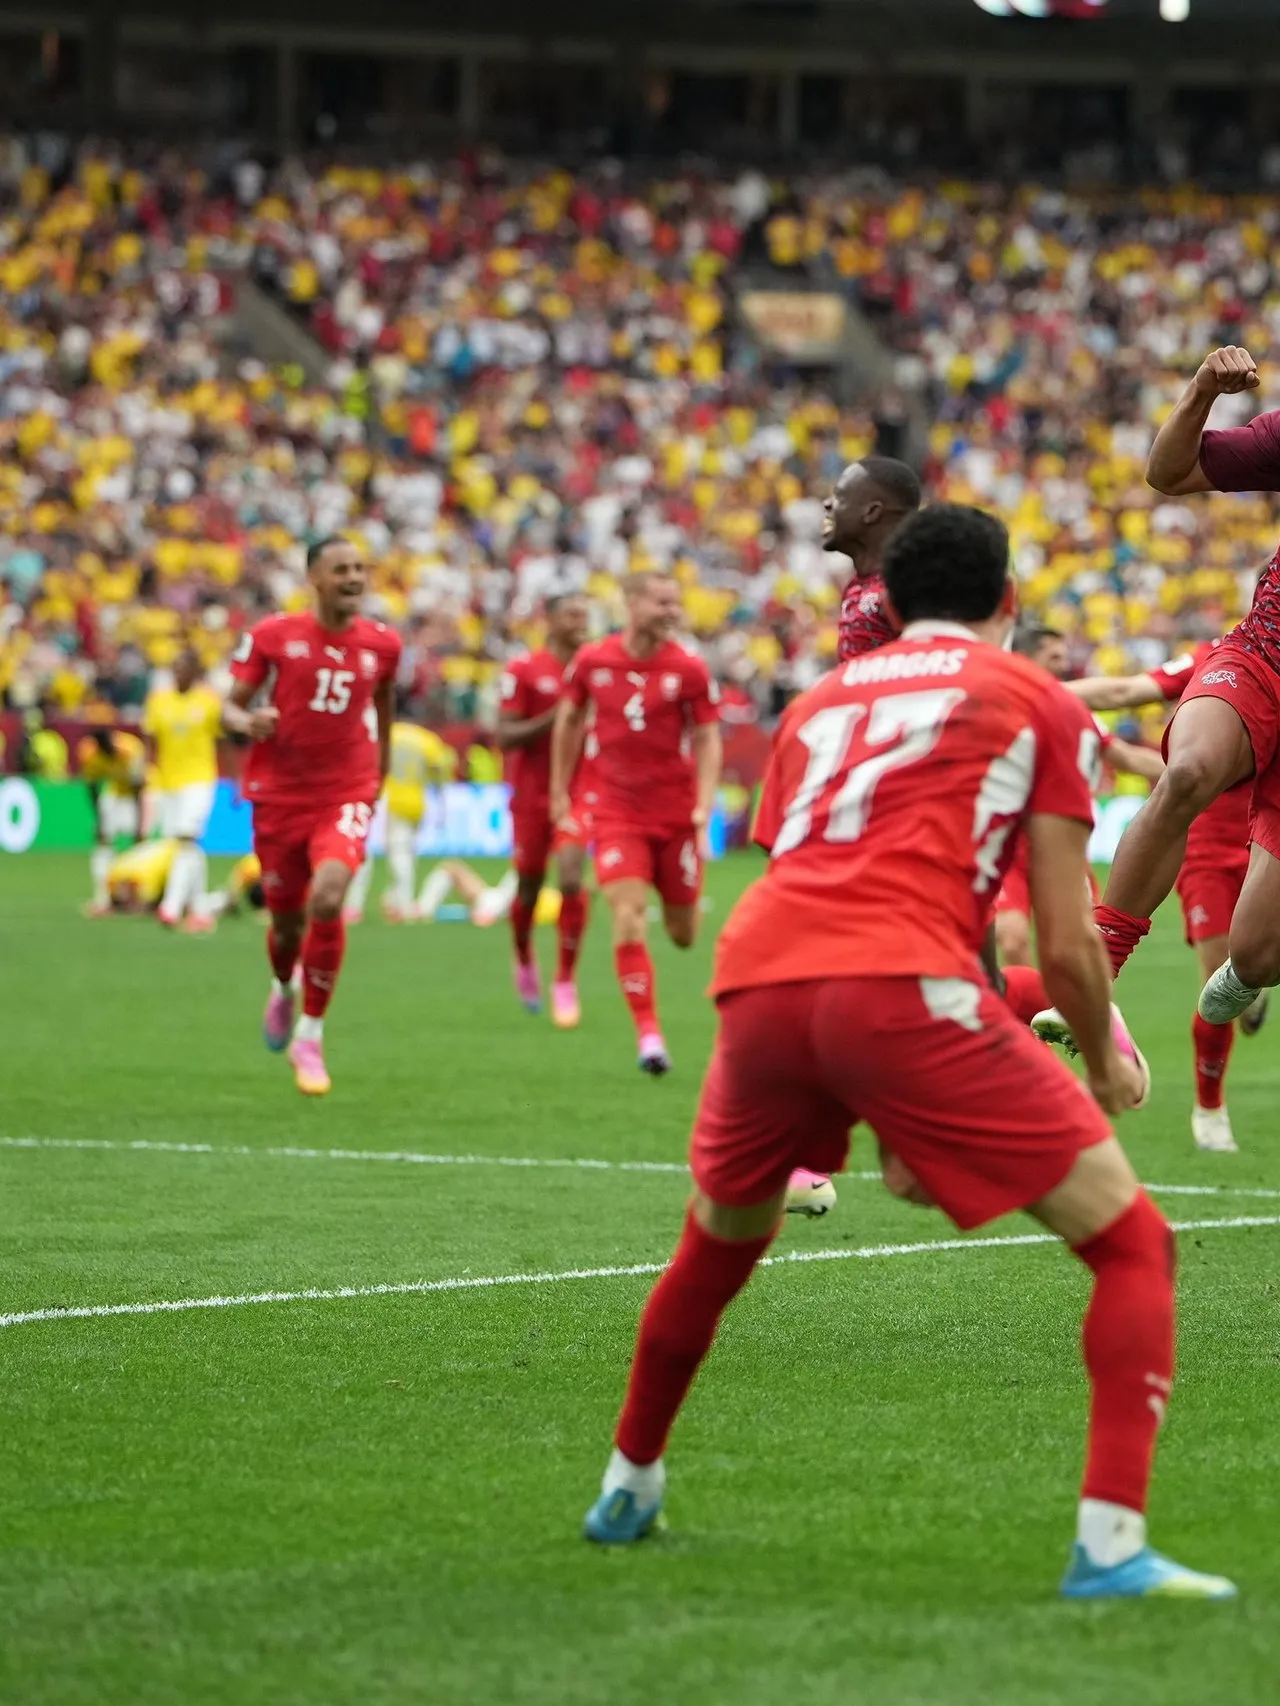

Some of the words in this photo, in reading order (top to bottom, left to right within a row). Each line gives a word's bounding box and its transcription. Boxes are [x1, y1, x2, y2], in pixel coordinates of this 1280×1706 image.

[842, 648, 968, 687] VARGAS
[309, 668, 355, 715] 15
[623, 692, 646, 732] 4
[771, 687, 967, 858] 17
[336, 801, 372, 840] 15
